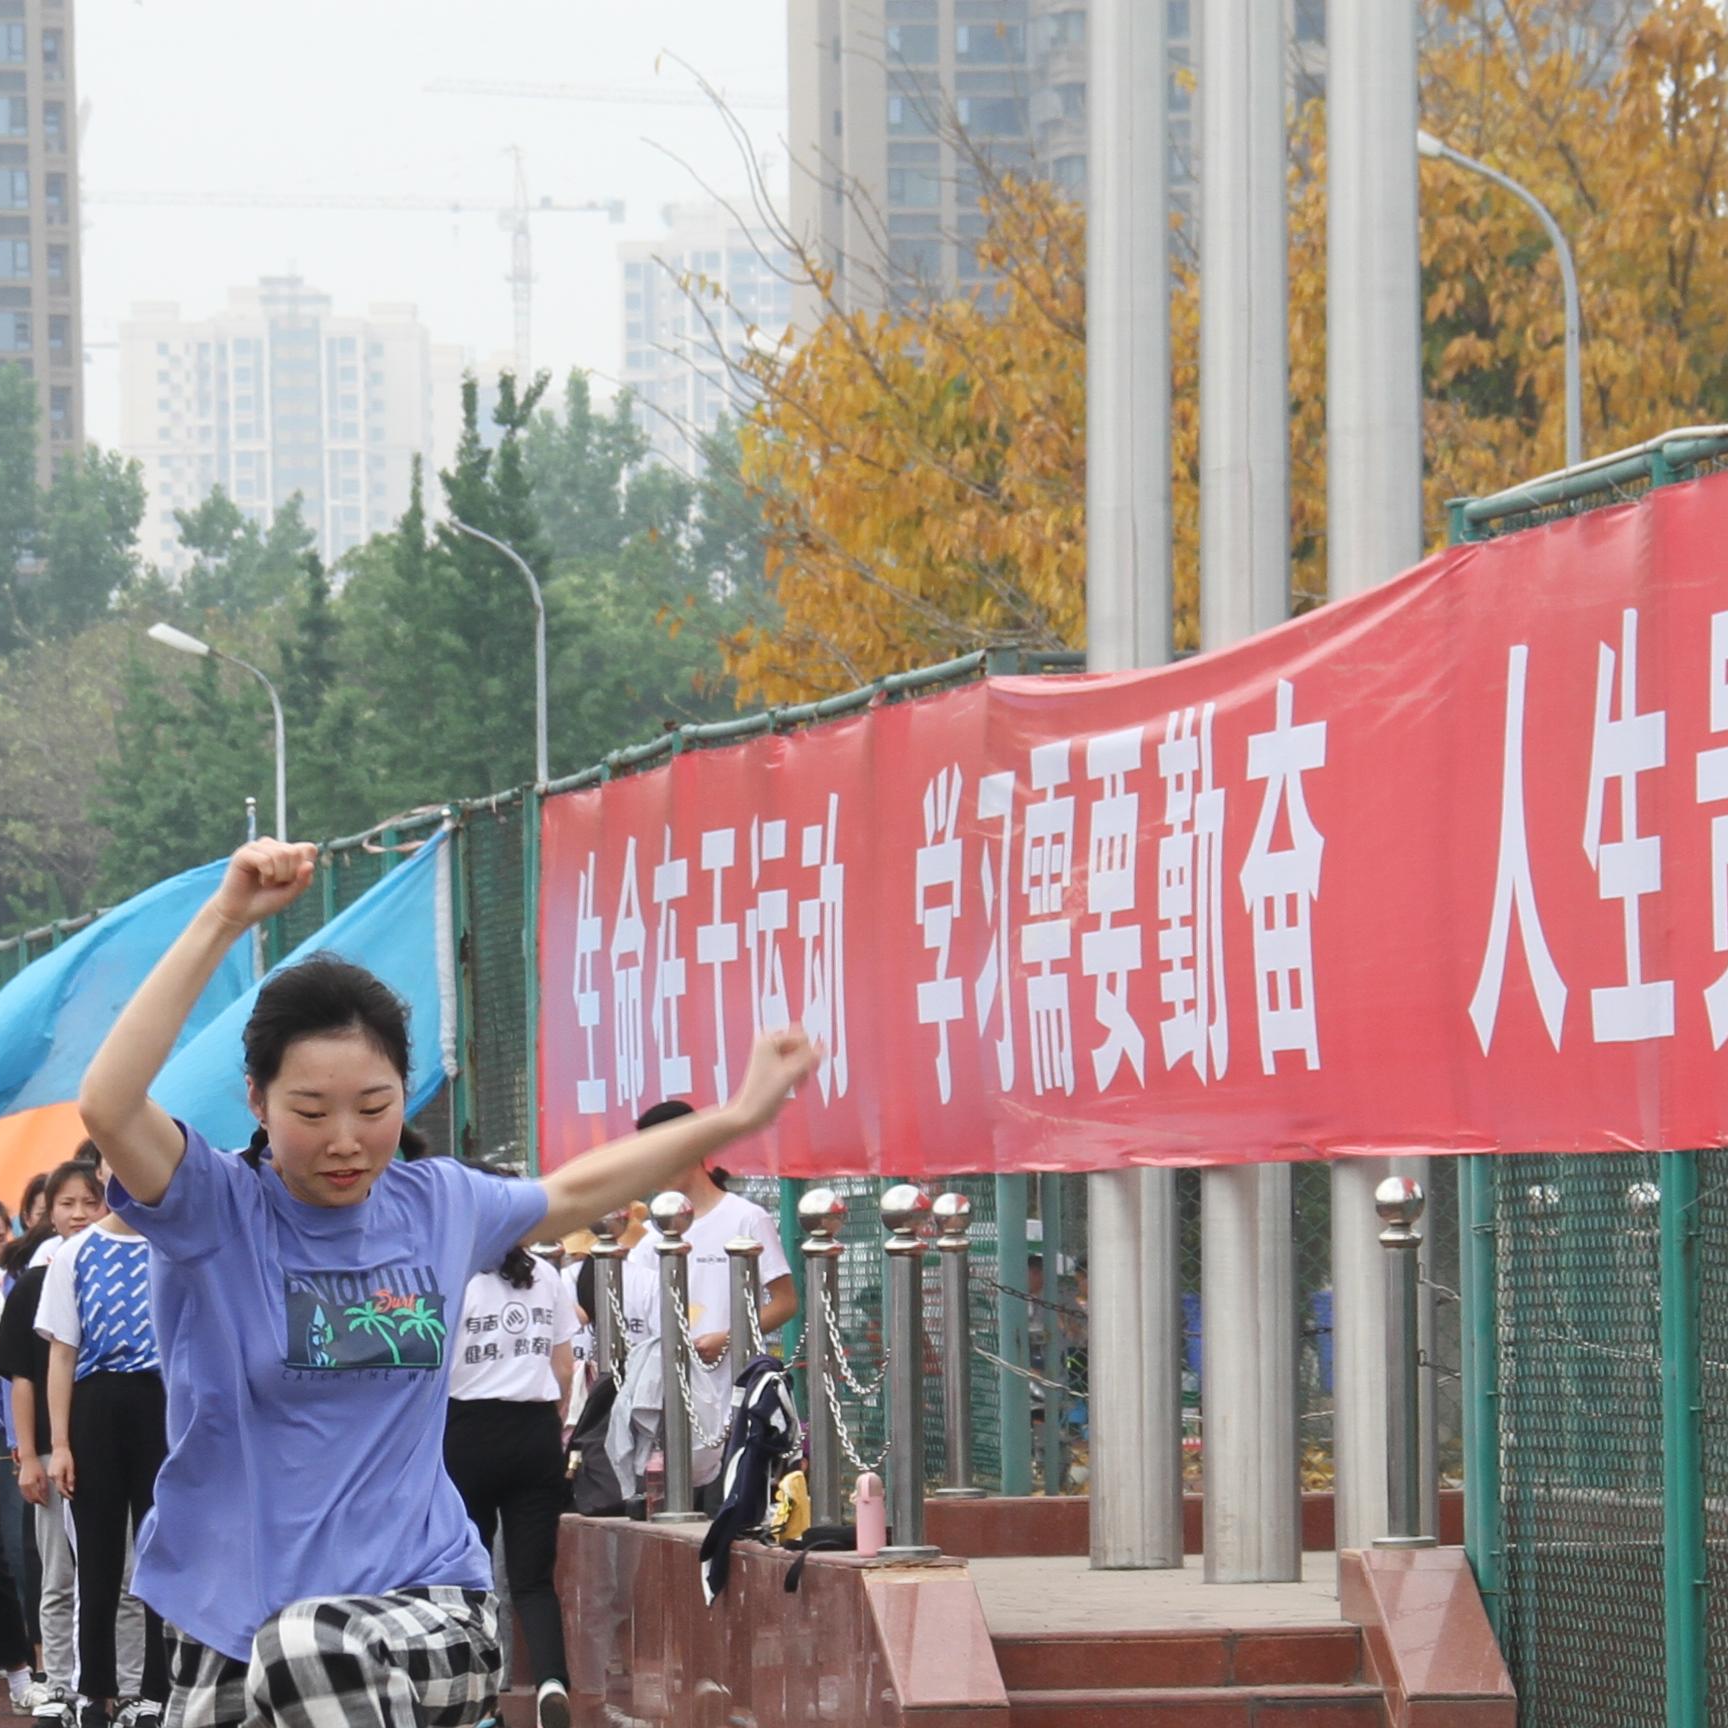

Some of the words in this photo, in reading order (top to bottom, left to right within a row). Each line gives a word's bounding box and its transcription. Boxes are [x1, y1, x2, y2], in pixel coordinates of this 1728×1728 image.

[573, 792, 846, 1116] 生命在于运动
[915, 678, 1326, 1106] 学习需要勤奋
